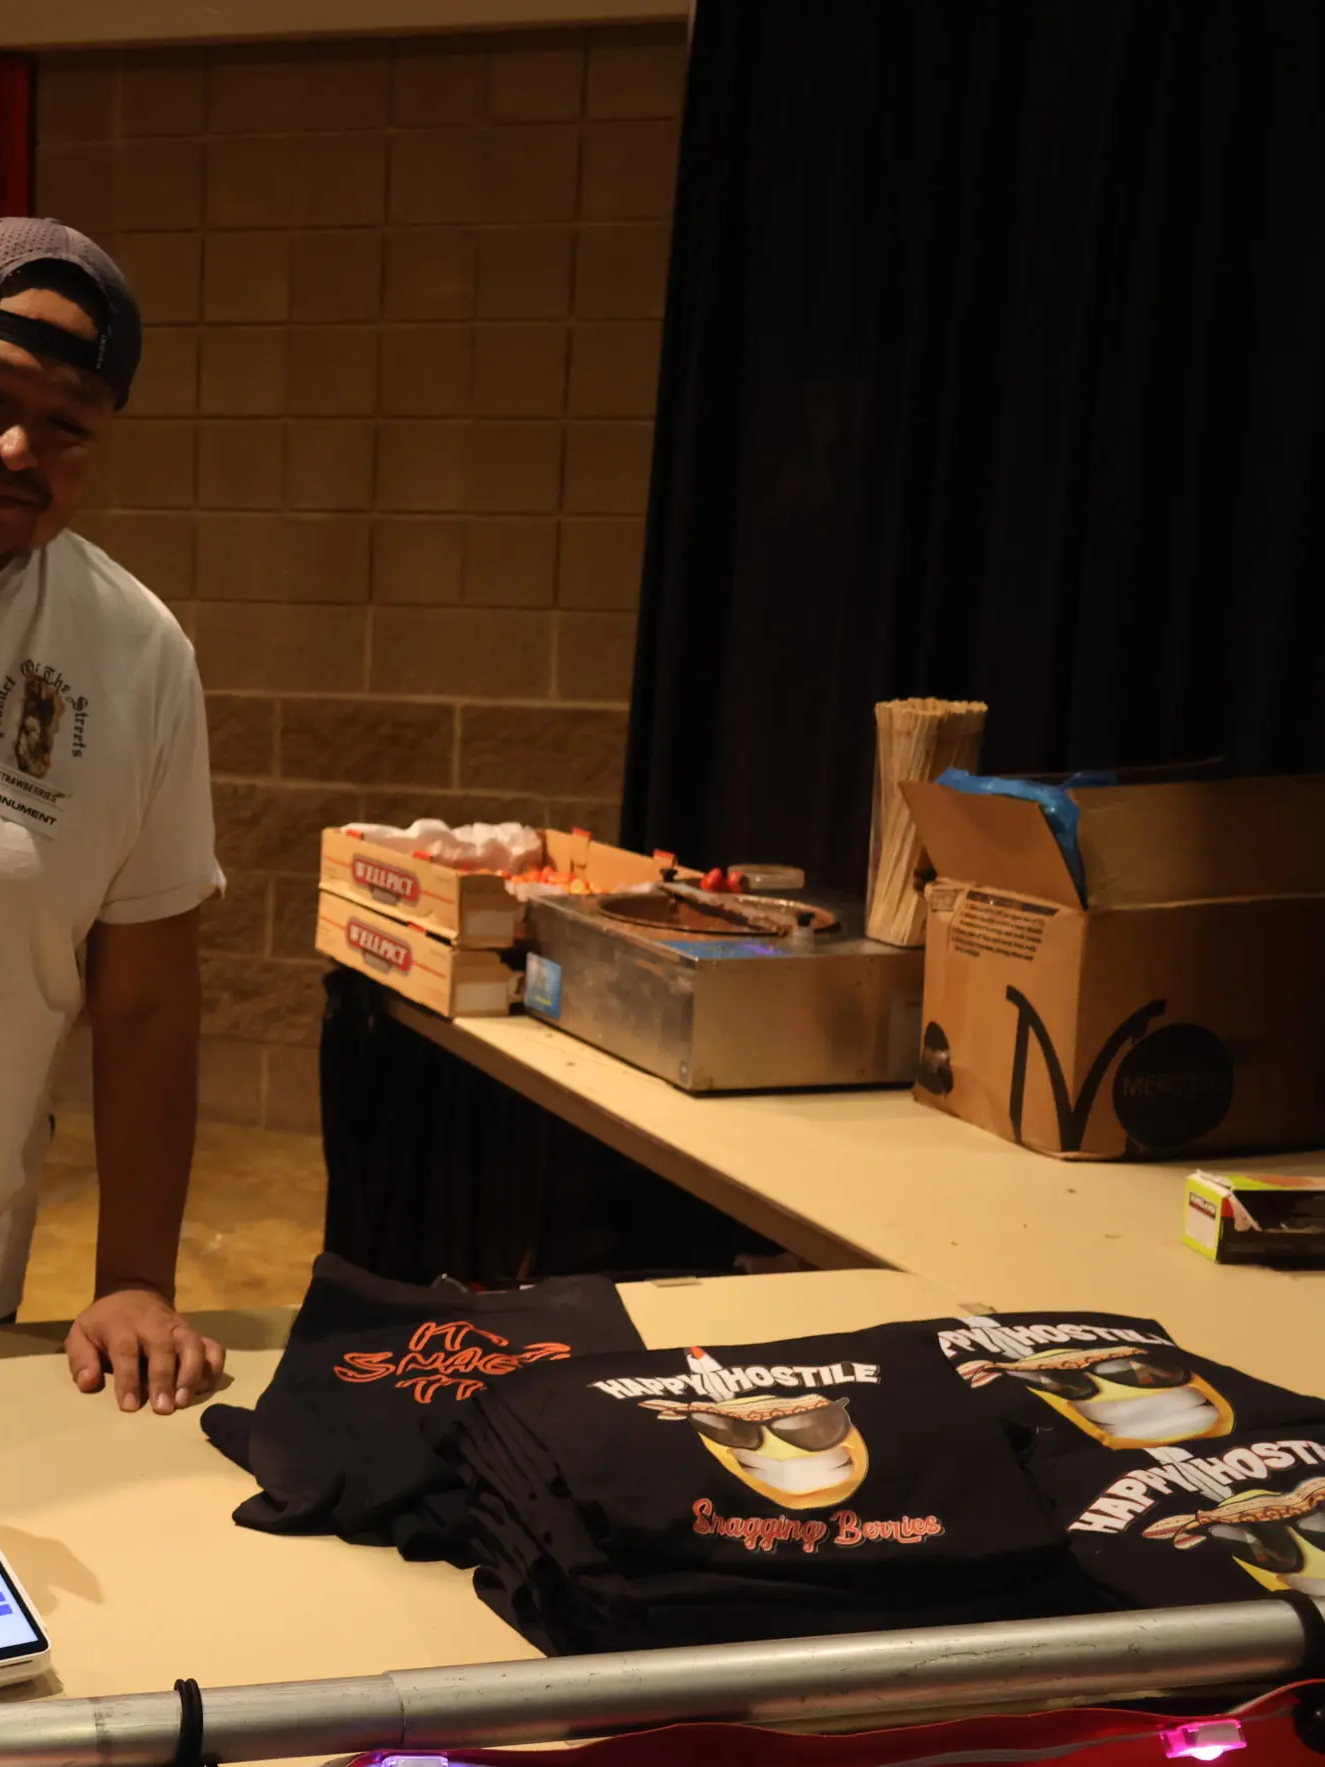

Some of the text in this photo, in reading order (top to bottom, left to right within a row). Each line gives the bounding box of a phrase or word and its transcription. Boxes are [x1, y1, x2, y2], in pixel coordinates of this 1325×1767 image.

[43, 665, 72, 695] The
[65, 697, 90, 758] Streets
[589, 1362, 881, 1399] HAPPY HOSTILE
[1067, 1439, 1325, 1534] HAPPY HOSTI
[691, 1497, 944, 1553] Snagging Berries
